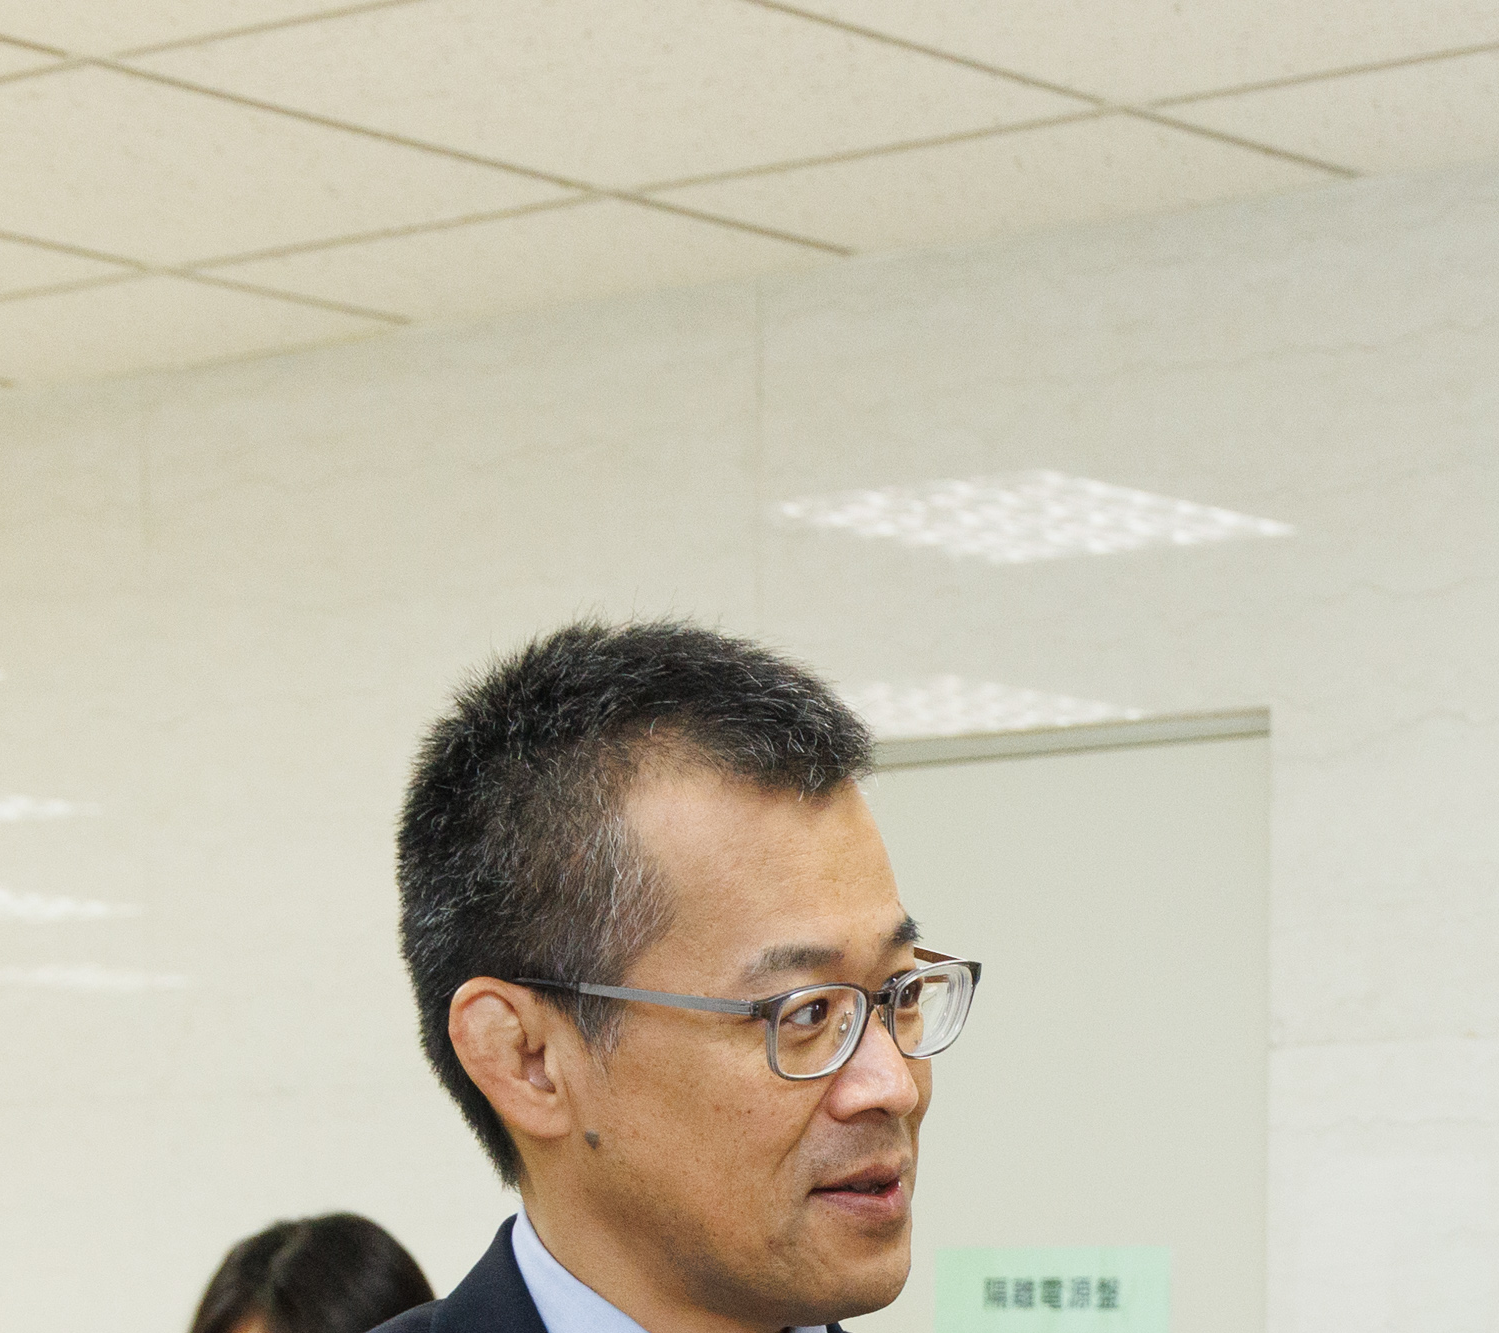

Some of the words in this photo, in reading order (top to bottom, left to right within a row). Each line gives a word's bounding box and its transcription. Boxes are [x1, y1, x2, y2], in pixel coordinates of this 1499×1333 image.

[984, 1276, 1120, 1310] 隔離電源盤
